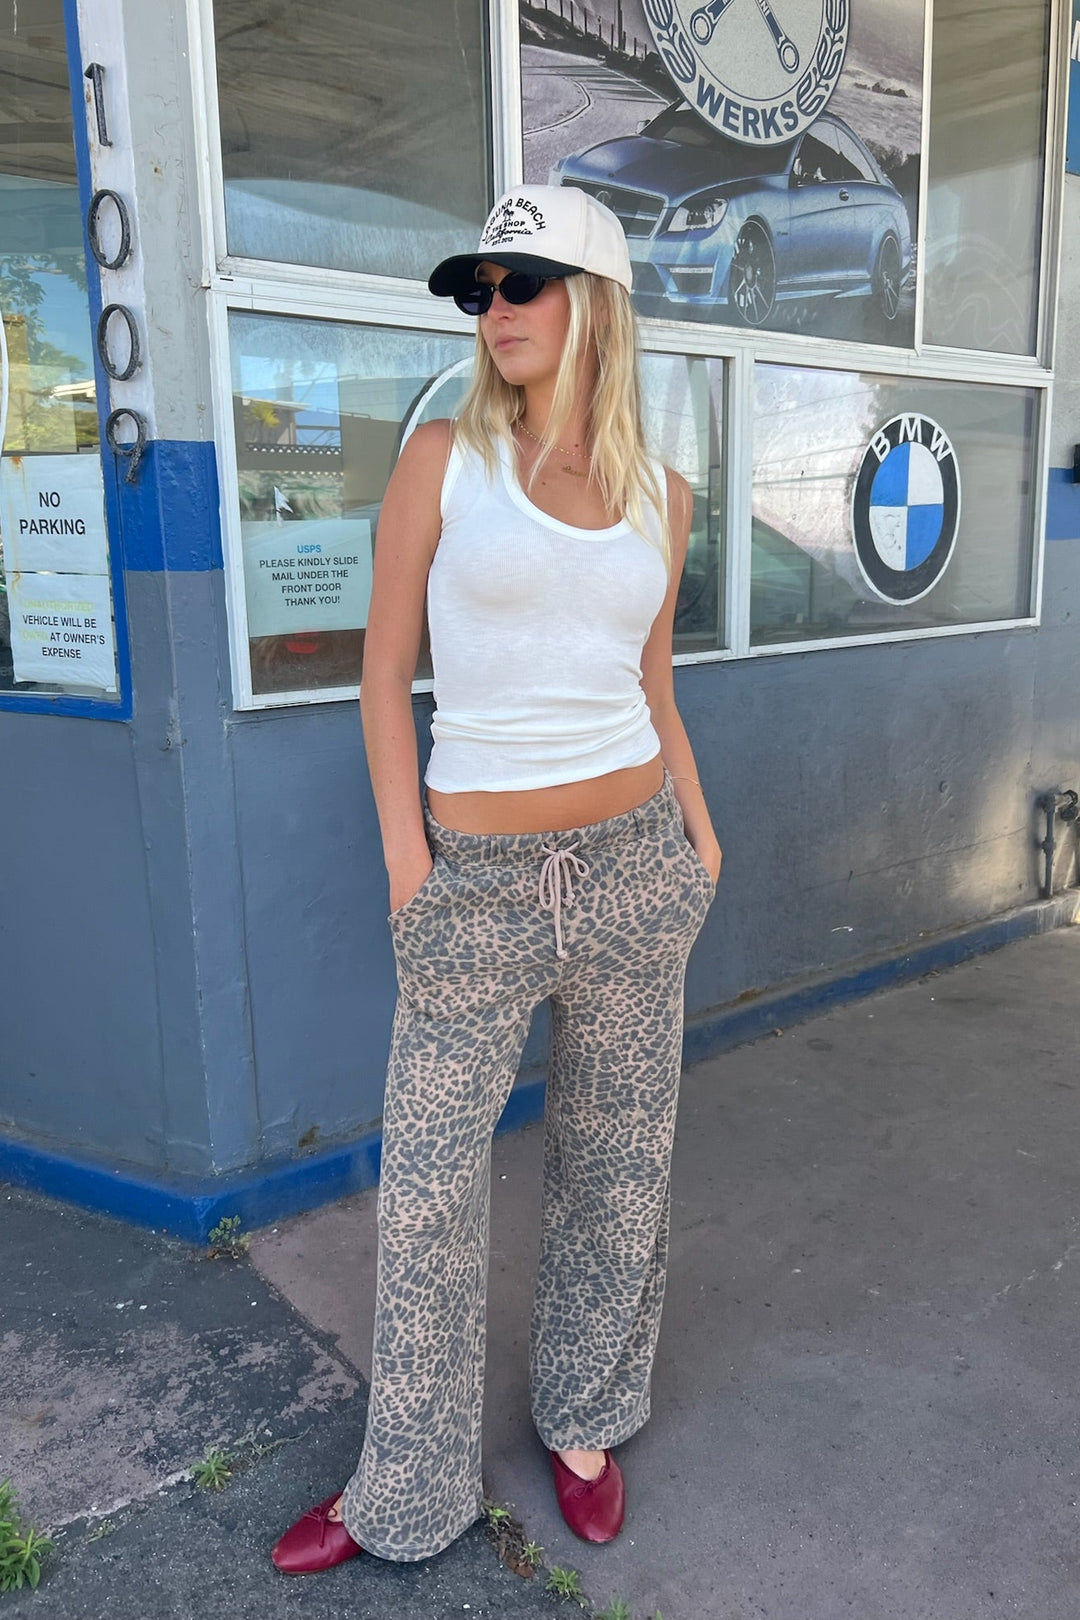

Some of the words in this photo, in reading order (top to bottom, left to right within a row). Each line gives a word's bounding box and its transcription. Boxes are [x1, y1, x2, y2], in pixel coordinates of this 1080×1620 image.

[696, 74, 799, 139] WERKS
[515, 198, 546, 230] BEACH
[504, 220, 526, 228] SHOP
[83, 62, 148, 484] 1009
[870, 417, 953, 463] BMW
[38, 491, 61, 508] NO
[19, 518, 86, 535] PARKING
[296, 544, 322, 554] USPS
[259, 558, 295, 568] PLEASE
[297, 557, 331, 567] KINDLY
[333, 556, 359, 565] SLIDE
[271, 572, 295, 581] MAIL
[297, 570, 329, 580] UNDER
[331, 569, 349, 578] THE
[281, 584, 313, 594] FRONT
[315, 582, 342, 592] DOOR
[285, 597, 316, 606] THANK
[318, 595, 340, 605] YOU!
[22, 615, 59, 626] VEHICLE
[60, 616, 82, 628] WILL
[84, 618, 96, 628] BE
[50, 632, 61, 642] AT
[63, 632, 105, 645] OWNER'S
[42, 647, 82, 659] EXPENSE
